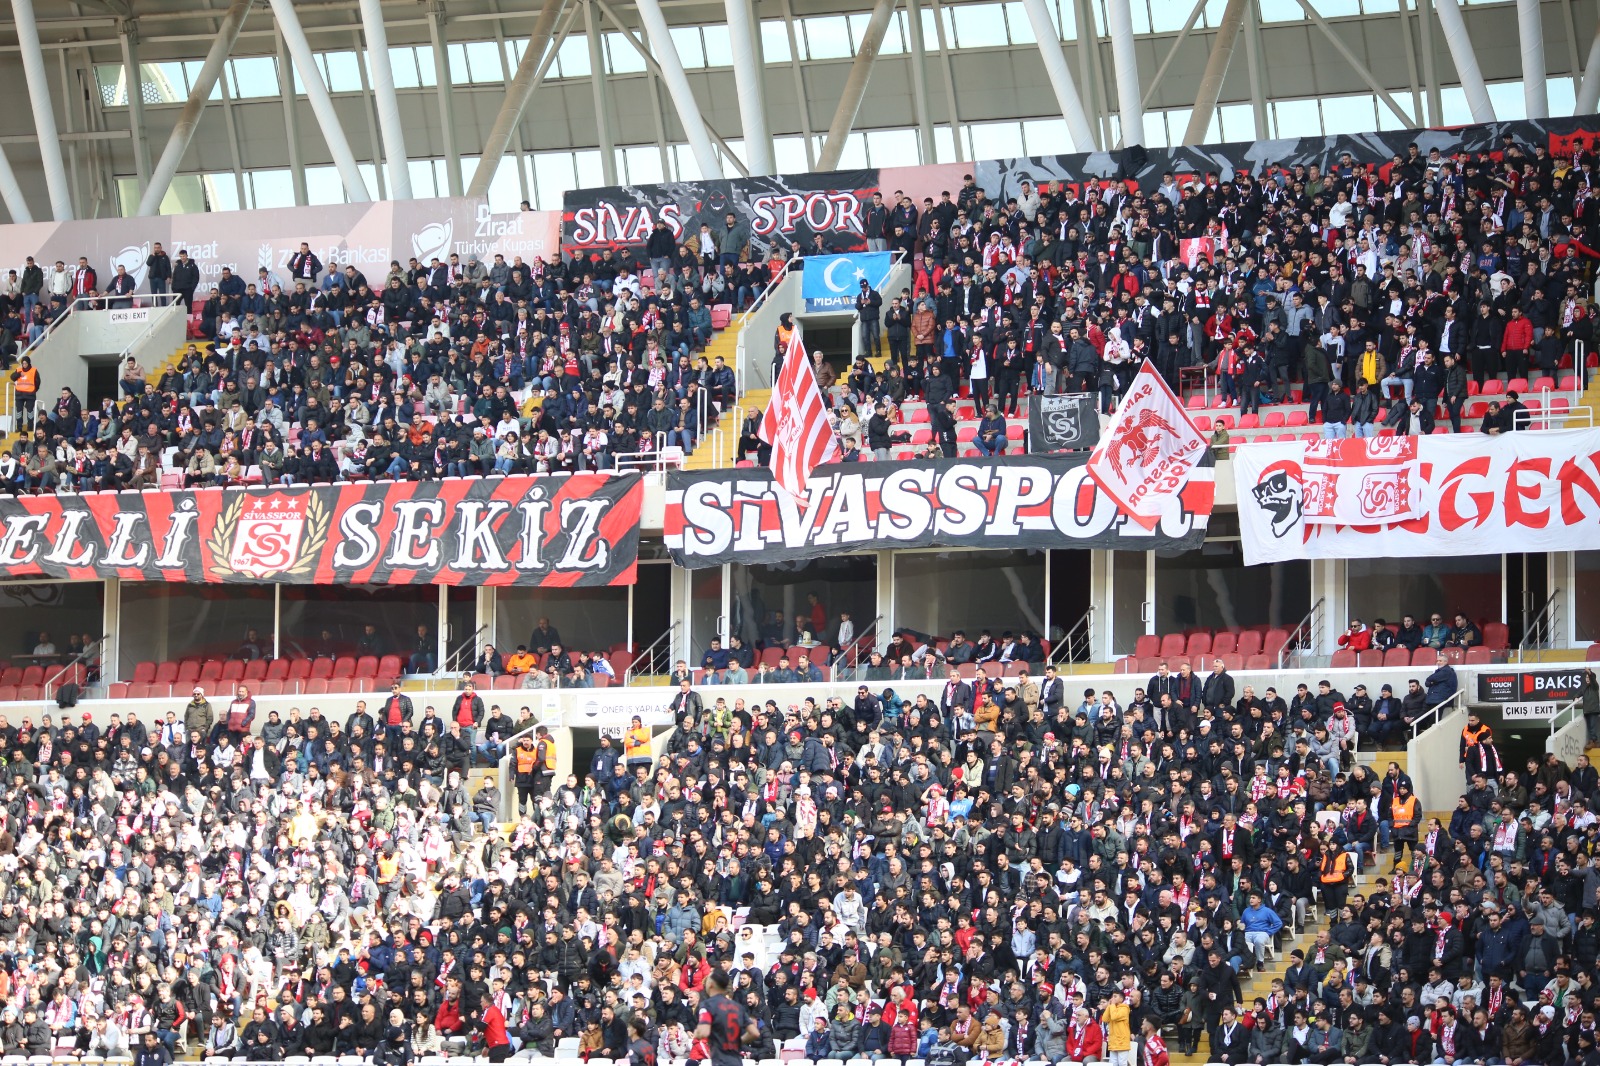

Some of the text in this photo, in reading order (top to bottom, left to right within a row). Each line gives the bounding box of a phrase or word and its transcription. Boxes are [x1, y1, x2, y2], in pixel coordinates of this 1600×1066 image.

[751, 192, 864, 234] SPOR
[475, 219, 524, 238] Ziraat
[455, 238, 544, 255] Türkiye Kupası
[328, 245, 390, 265] Bankası
[112, 312, 128, 322] ÇIKIŞ
[133, 311, 147, 320] EXIT
[243, 510, 302, 520] SİVASSPOR
[0, 485, 609, 570] ELLİ SEKİZ
[233, 558, 251, 567] 1967
[1535, 674, 1582, 690] BAKIŞ
[1548, 690, 1568, 699] door
[1505, 706, 1528, 716] ÇIKIŞ
[1534, 705, 1554, 715] EXIT
[726, 1012, 741, 1043] 5
